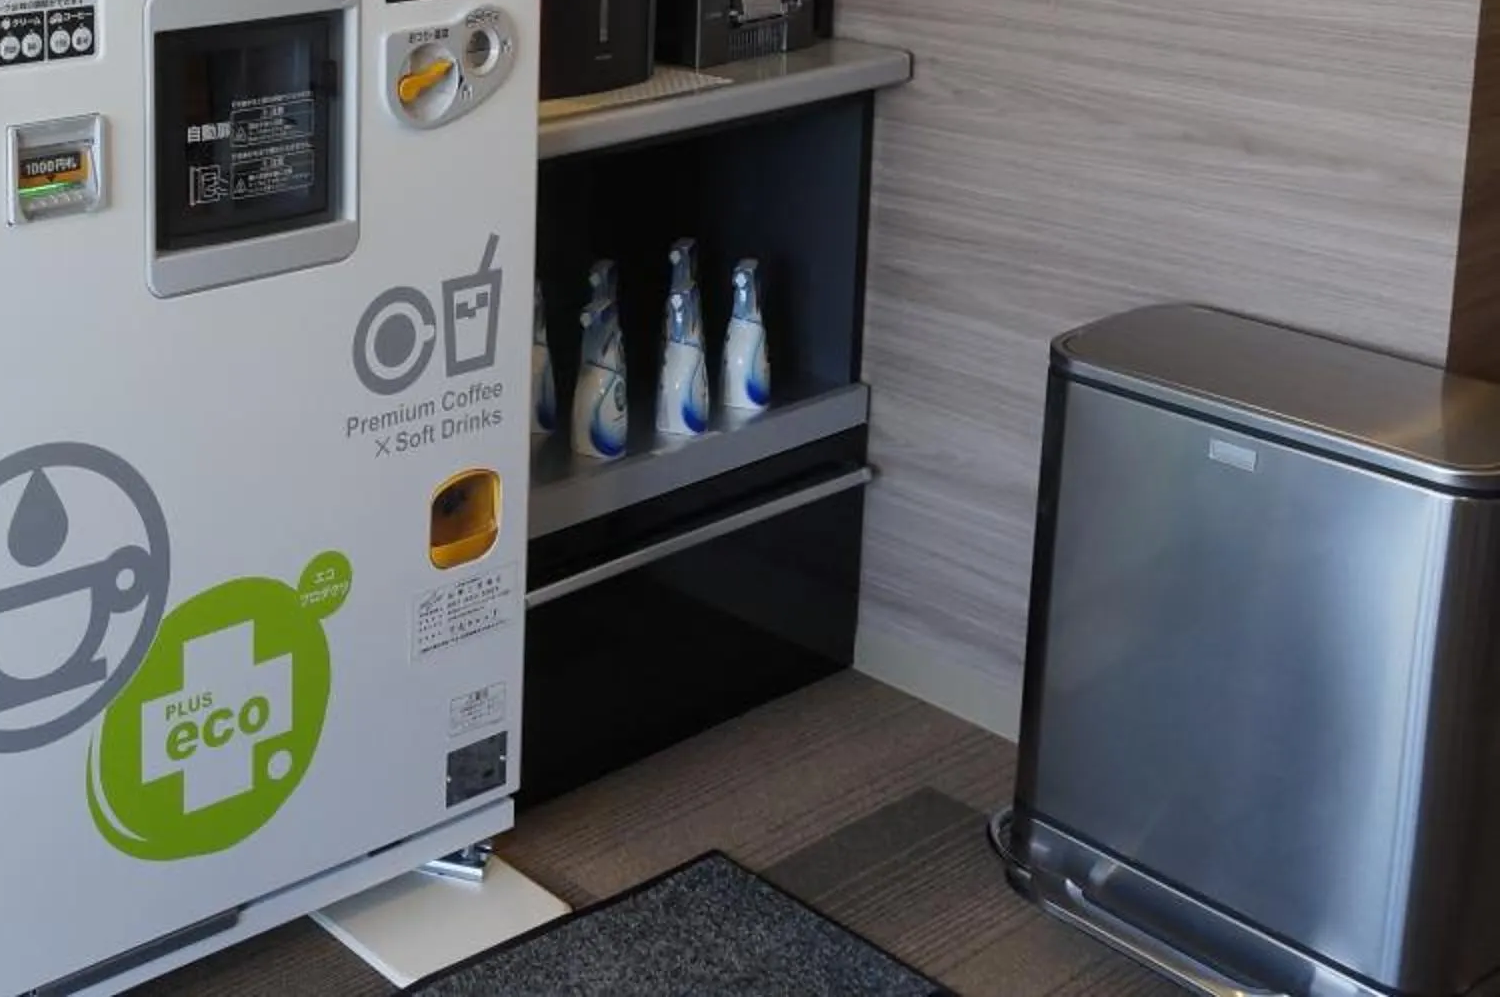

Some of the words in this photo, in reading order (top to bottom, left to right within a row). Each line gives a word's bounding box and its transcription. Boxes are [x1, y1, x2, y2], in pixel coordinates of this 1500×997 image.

[346, 399, 435, 438] Premium
[441, 382, 503, 412] Coffee
[395, 425, 435, 452] Soft
[441, 409, 503, 440] Drinks
[165, 691, 213, 722] PLUS
[165, 695, 270, 761] eco
